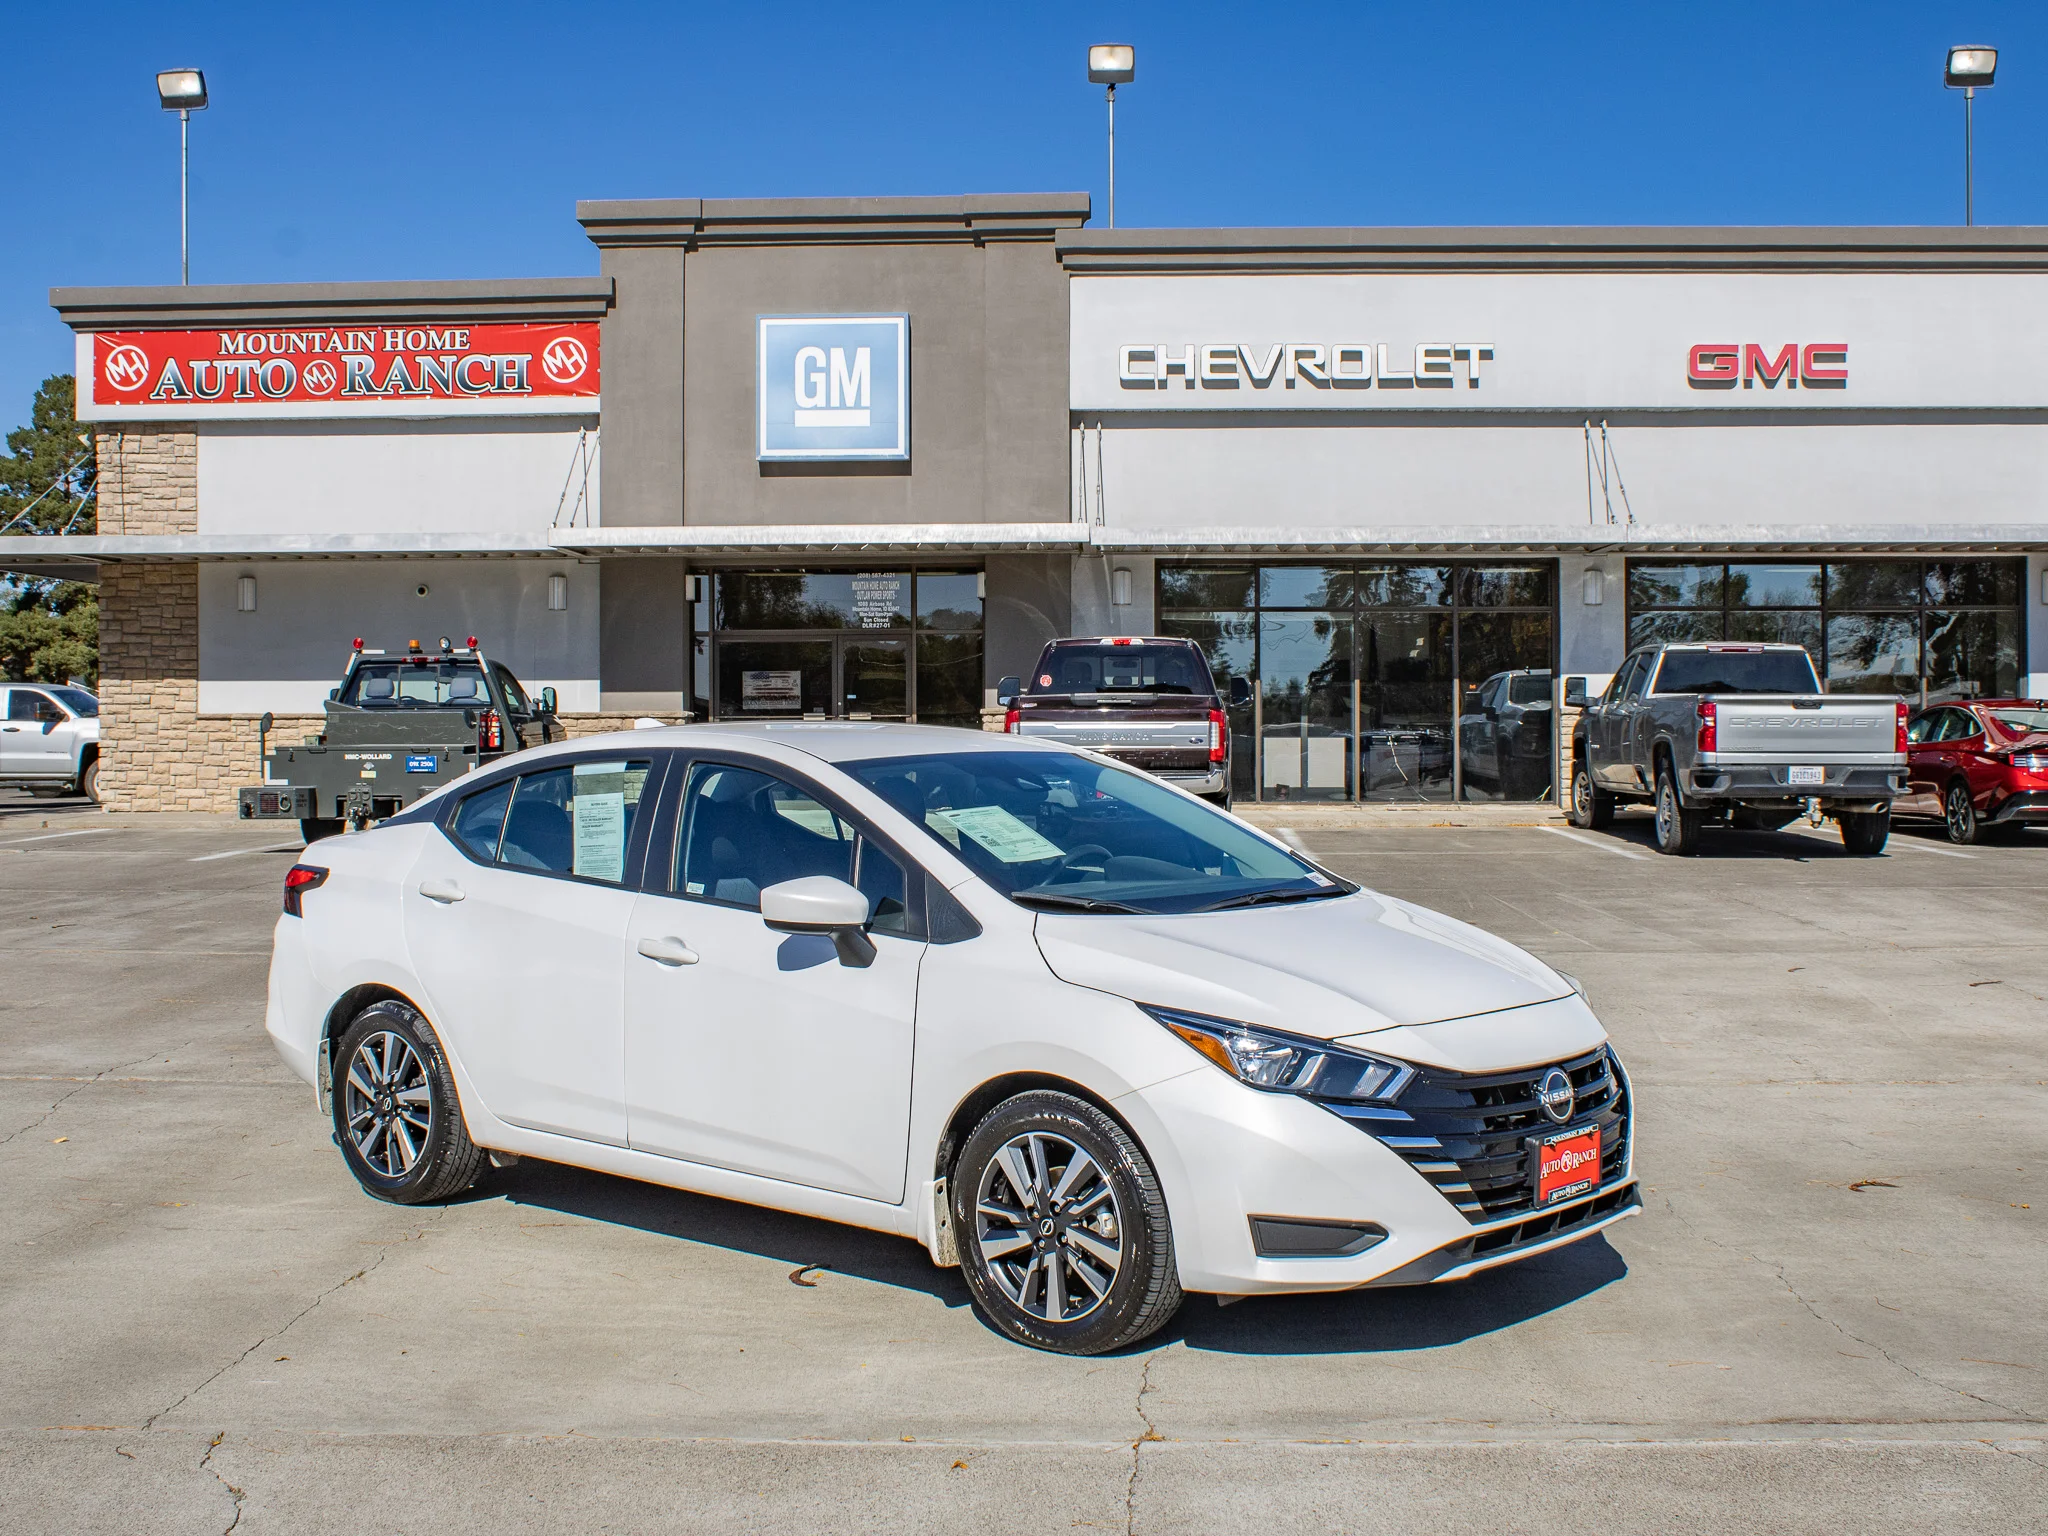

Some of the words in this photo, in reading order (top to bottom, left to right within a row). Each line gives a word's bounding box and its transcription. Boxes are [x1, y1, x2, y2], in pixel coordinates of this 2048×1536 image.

[218, 330, 378, 355] MOUNTAIN
[382, 328, 471, 352] HOME
[150, 357, 297, 400] AUTO
[341, 353, 533, 396] RANCH
[1119, 343, 1494, 381] CHEVROLET
[1688, 343, 1848, 380] GMC
[795, 346, 871, 409] GM
[1729, 717, 1885, 728] CHEVROLET
[1541, 1089, 1574, 1104] NISSAN
[1540, 1159, 1561, 1179] AUTO
[1572, 1148, 1597, 1169] RANCH
[1551, 1190, 1566, 1201] AUTO
